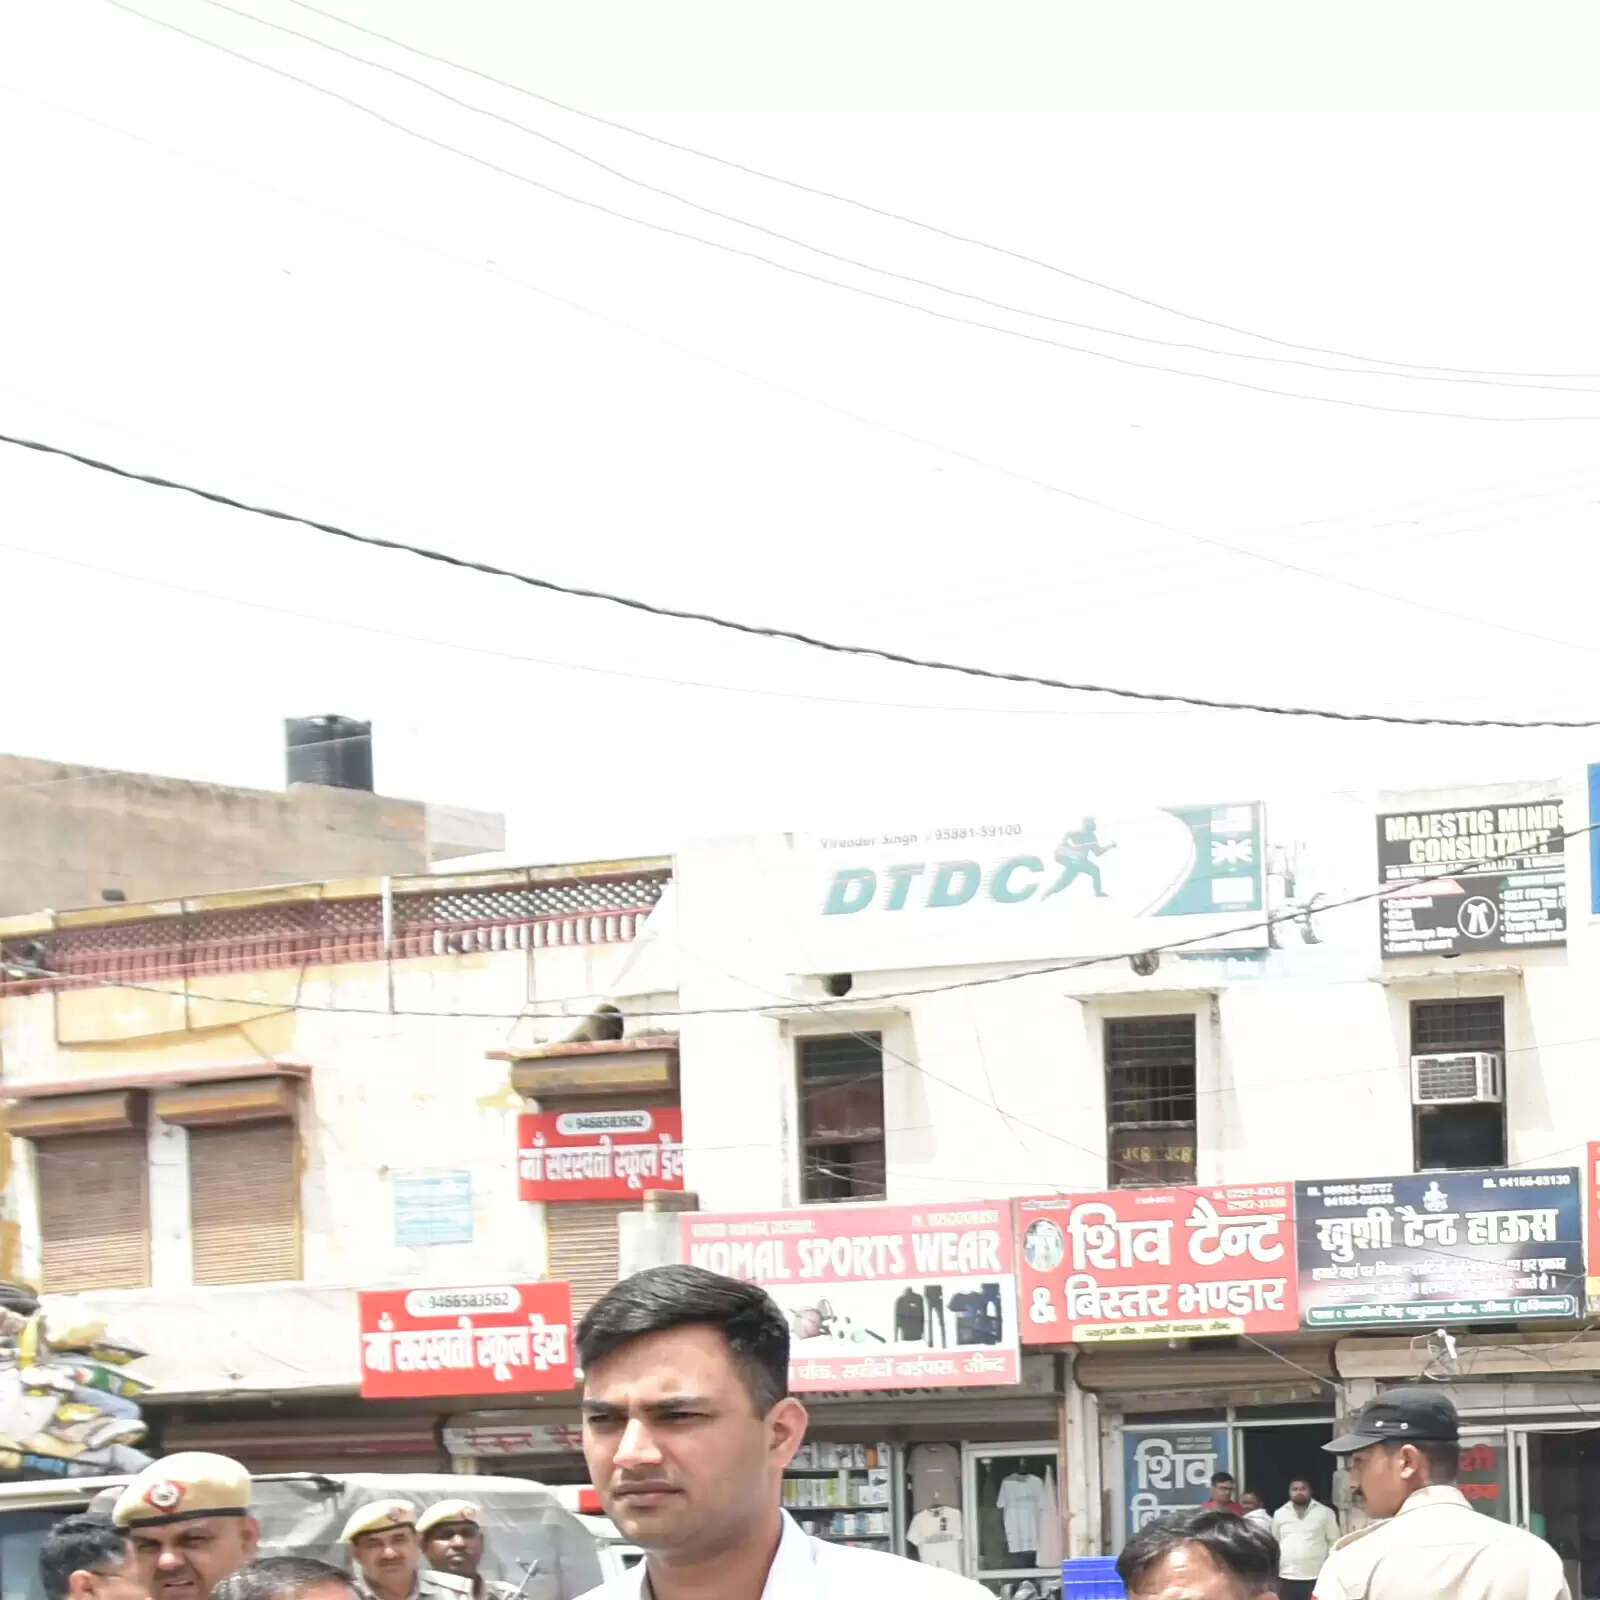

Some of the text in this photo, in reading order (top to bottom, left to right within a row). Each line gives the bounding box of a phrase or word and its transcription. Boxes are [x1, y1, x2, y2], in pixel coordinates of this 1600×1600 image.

[881, 833, 919, 848] Singh
[1385, 809, 1494, 842] MAJESTIC
[1409, 830, 1551, 864] CONSULTANT
[820, 855, 1046, 917] DTDC
[612, 1145, 658, 1190] स्कूल
[691, 1229, 1002, 1281] KOMAL SPORTS WEAR
[1066, 1195, 1286, 1271] शिव टैन्ट
[1315, 1204, 1559, 1262] खुशी टैन्ट हाऊस
[429, 1291, 510, 1310] 9466583562
[1029, 1286, 1057, 1324] &
[1063, 1273, 1172, 1321] बिस्तर
[1177, 1278, 1288, 1316] भण्डार
[392, 1314, 474, 1370] सरस्वती
[474, 1326, 530, 1382] स्कूल
[1133, 1437, 1218, 1489] शिव
